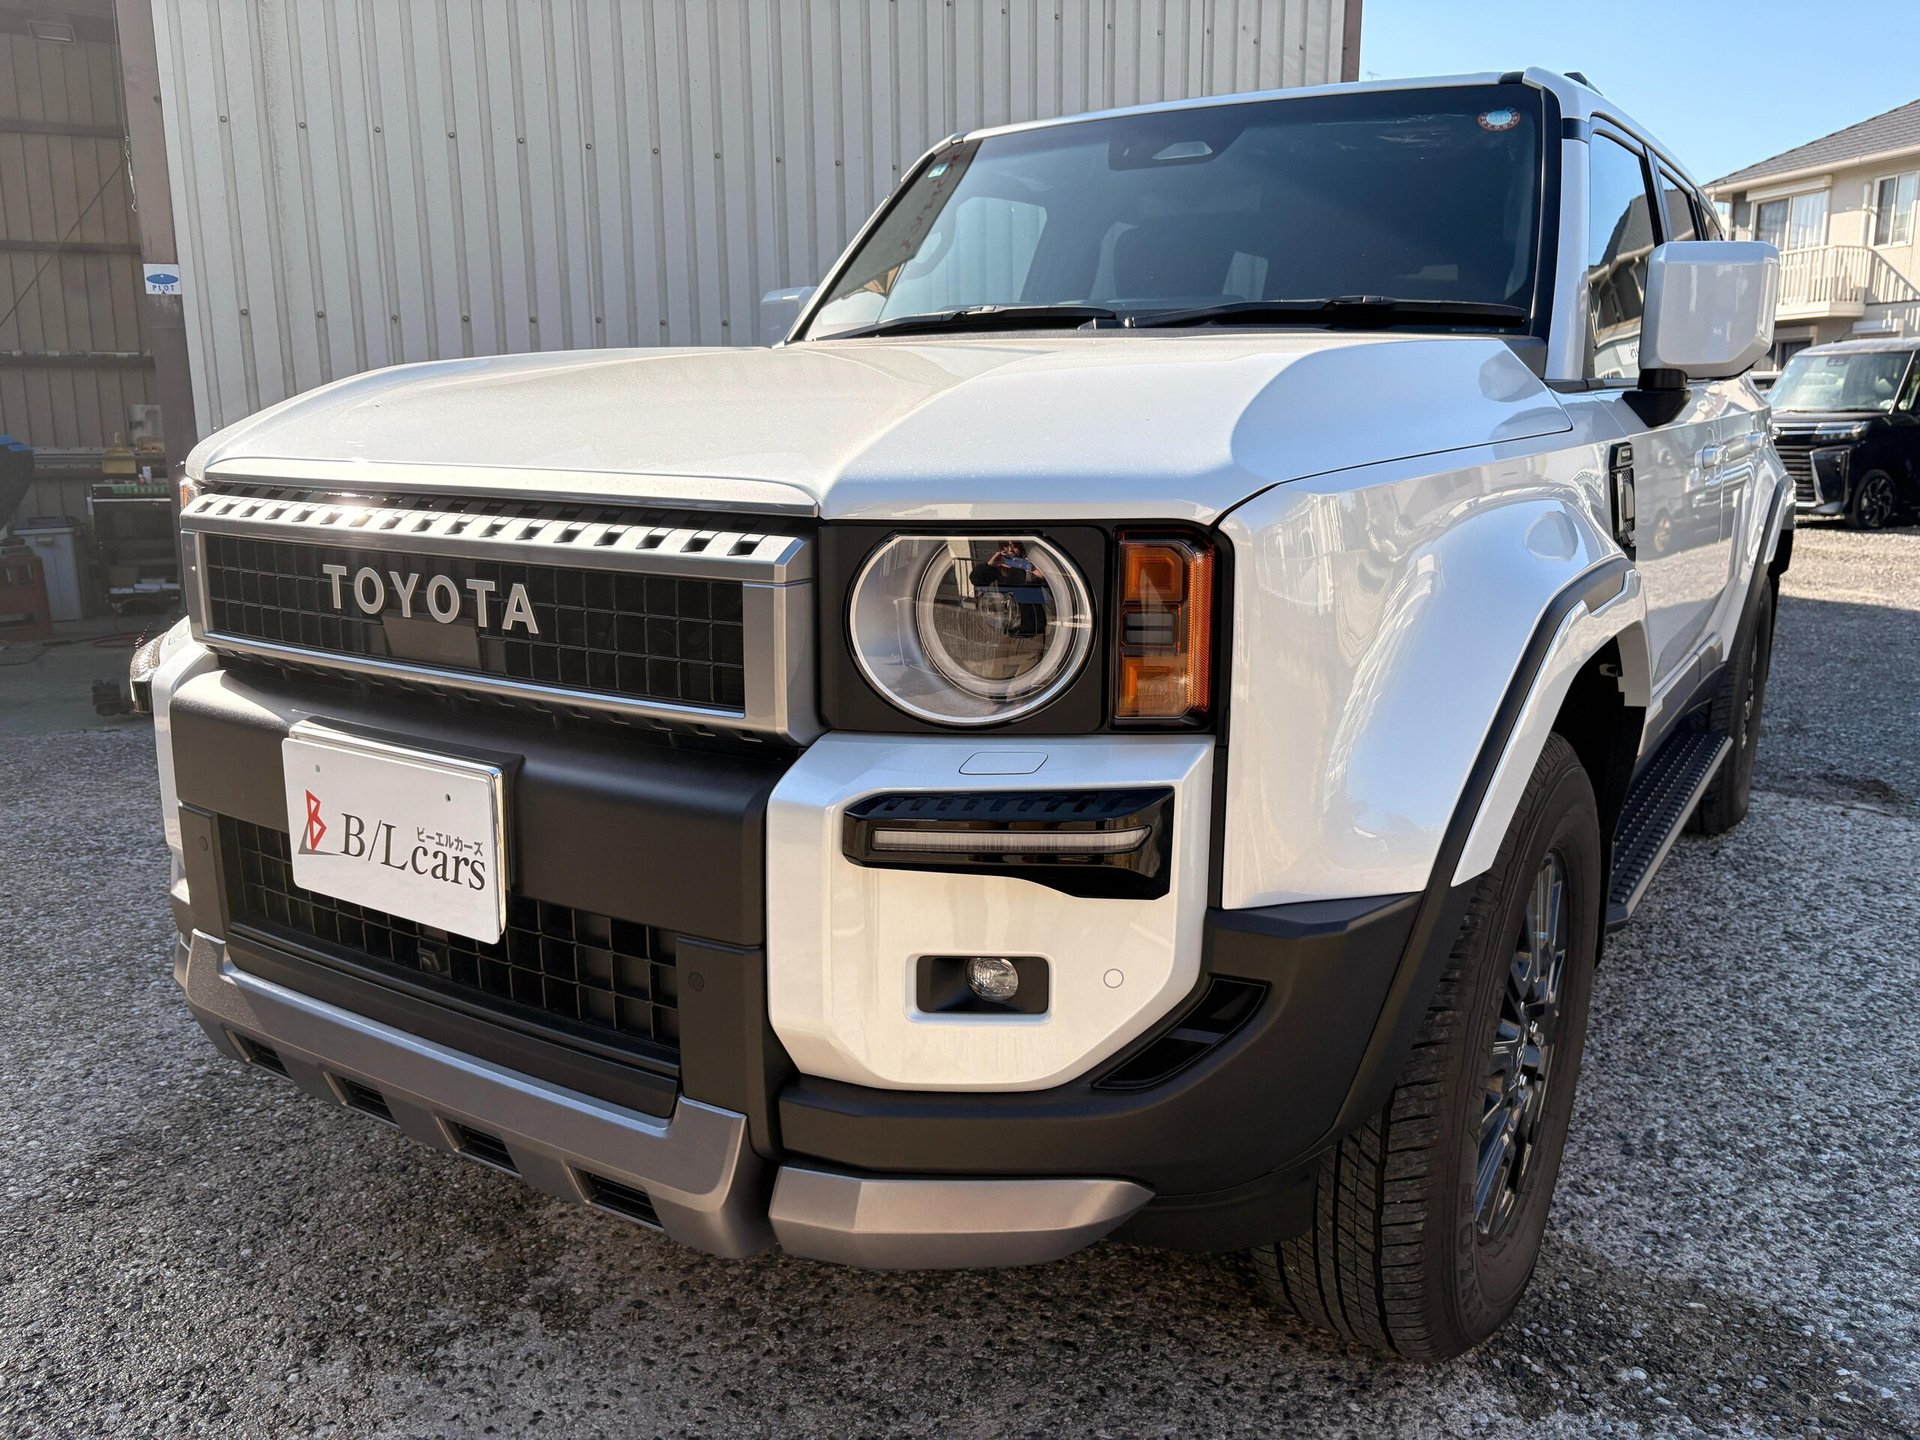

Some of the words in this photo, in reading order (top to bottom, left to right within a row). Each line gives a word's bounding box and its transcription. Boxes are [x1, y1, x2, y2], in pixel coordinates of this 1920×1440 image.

[322, 564, 539, 634] TOYOTA
[416, 826, 484, 857] ビーエルカーズ
